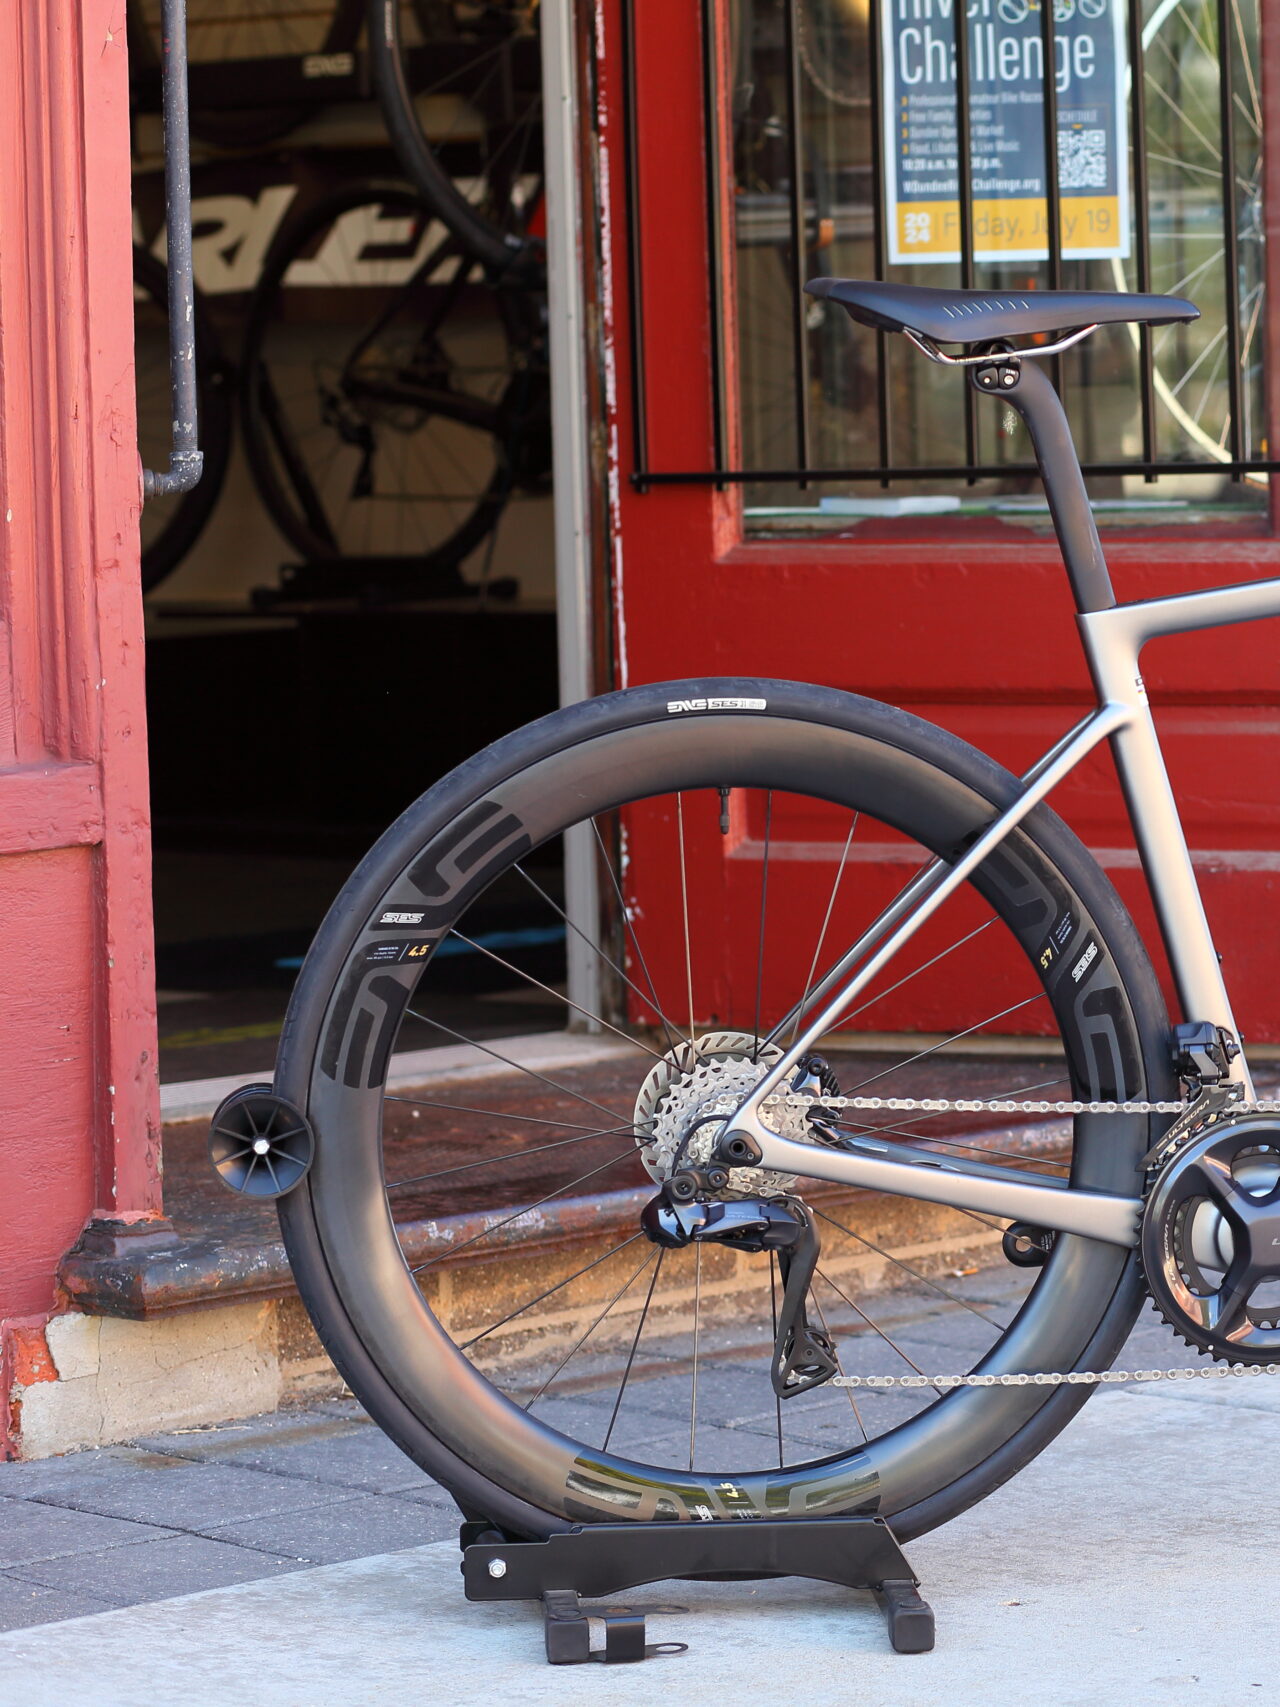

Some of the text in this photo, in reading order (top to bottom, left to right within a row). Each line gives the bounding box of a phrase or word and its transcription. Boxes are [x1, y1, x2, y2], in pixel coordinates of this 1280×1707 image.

[899, 23, 1095, 92] Chllenge
[943, 211, 1024, 241] Fday,
[1032, 210, 1078, 237] Juy
[1087, 208, 1111, 233] 19
[379, 912, 426, 924] SES
[408, 944, 430, 957] 4.5
[1040, 947, 1054, 969] 4.5
[1071, 941, 1098, 984] SES
[1168, 1099, 1210, 1140] ULTEGRA
[720, 1482, 740, 1498] 4.5
